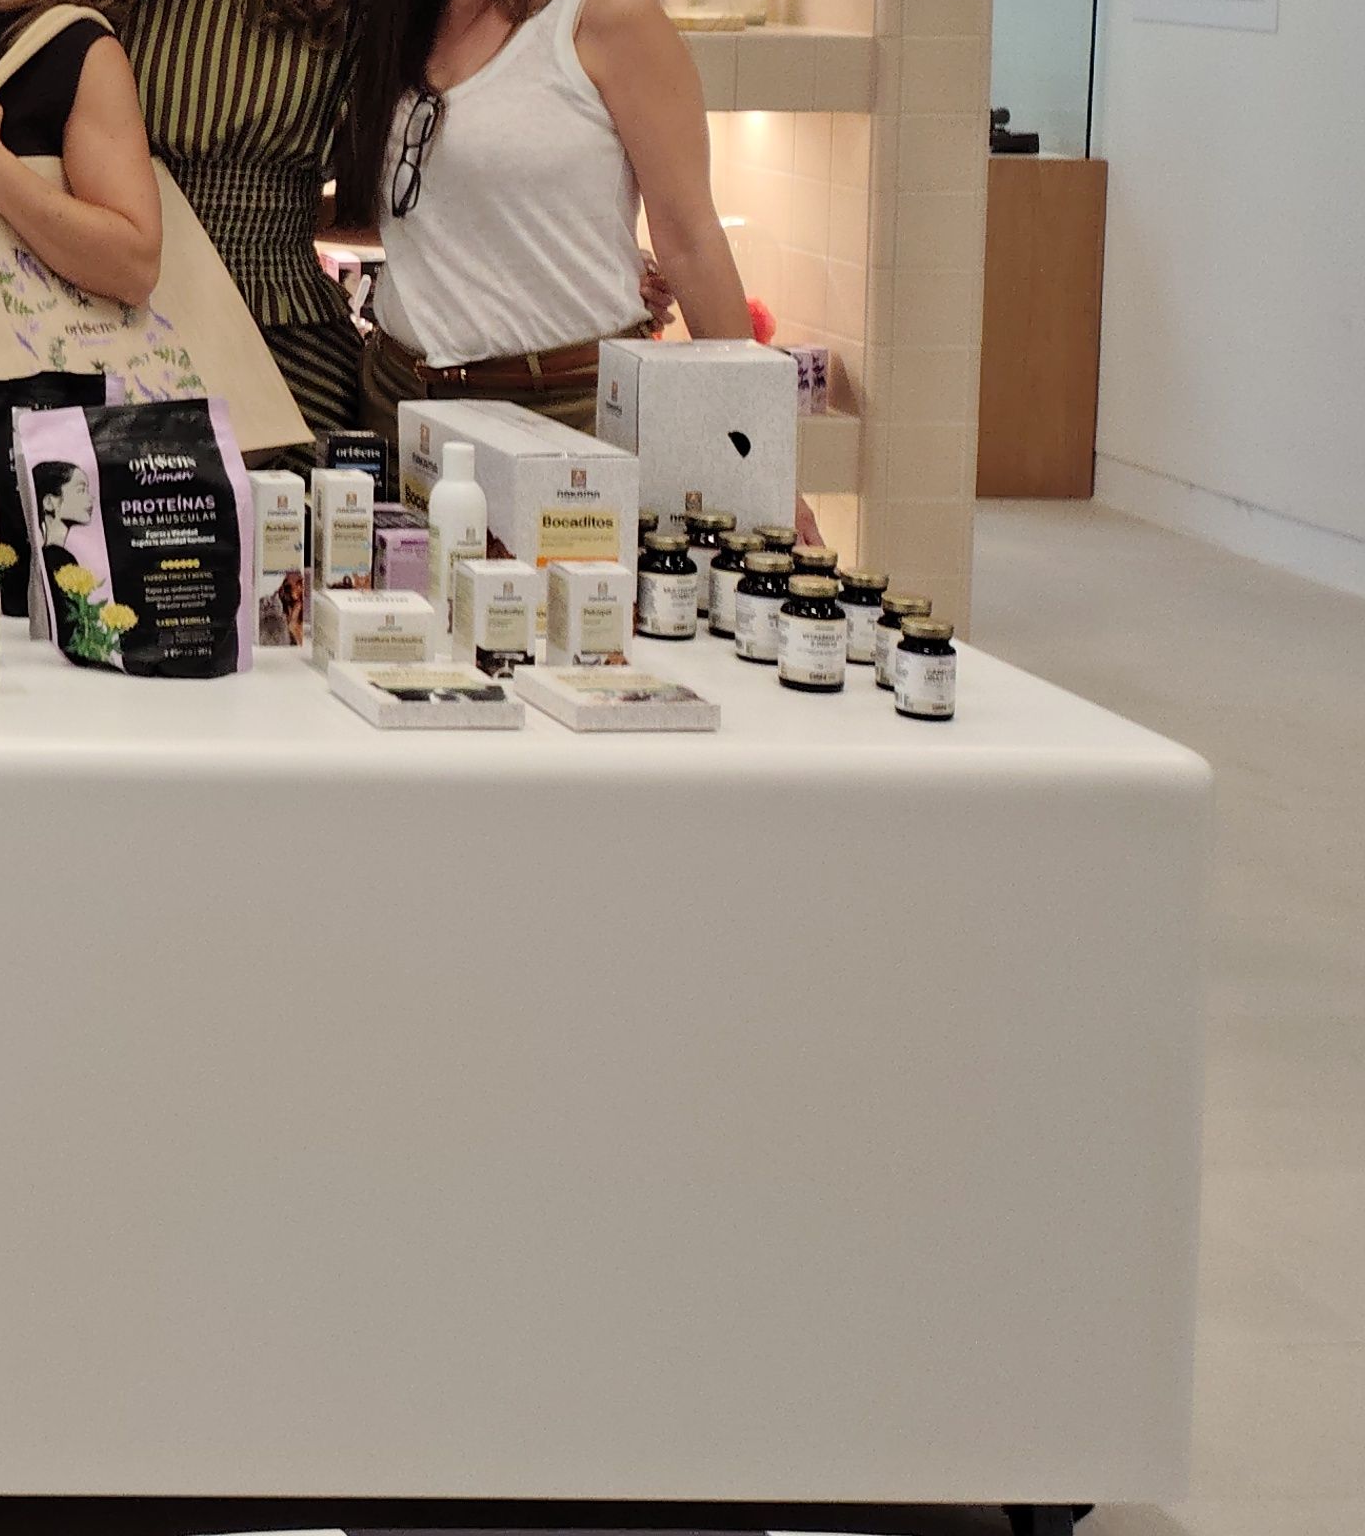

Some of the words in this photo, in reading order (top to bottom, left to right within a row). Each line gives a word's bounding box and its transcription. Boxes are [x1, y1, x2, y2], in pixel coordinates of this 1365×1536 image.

[120, 493, 216, 516] PROTEÍNAS
[156, 511, 217, 525] MUSCULAR
[542, 512, 614, 530] Bocaditos
